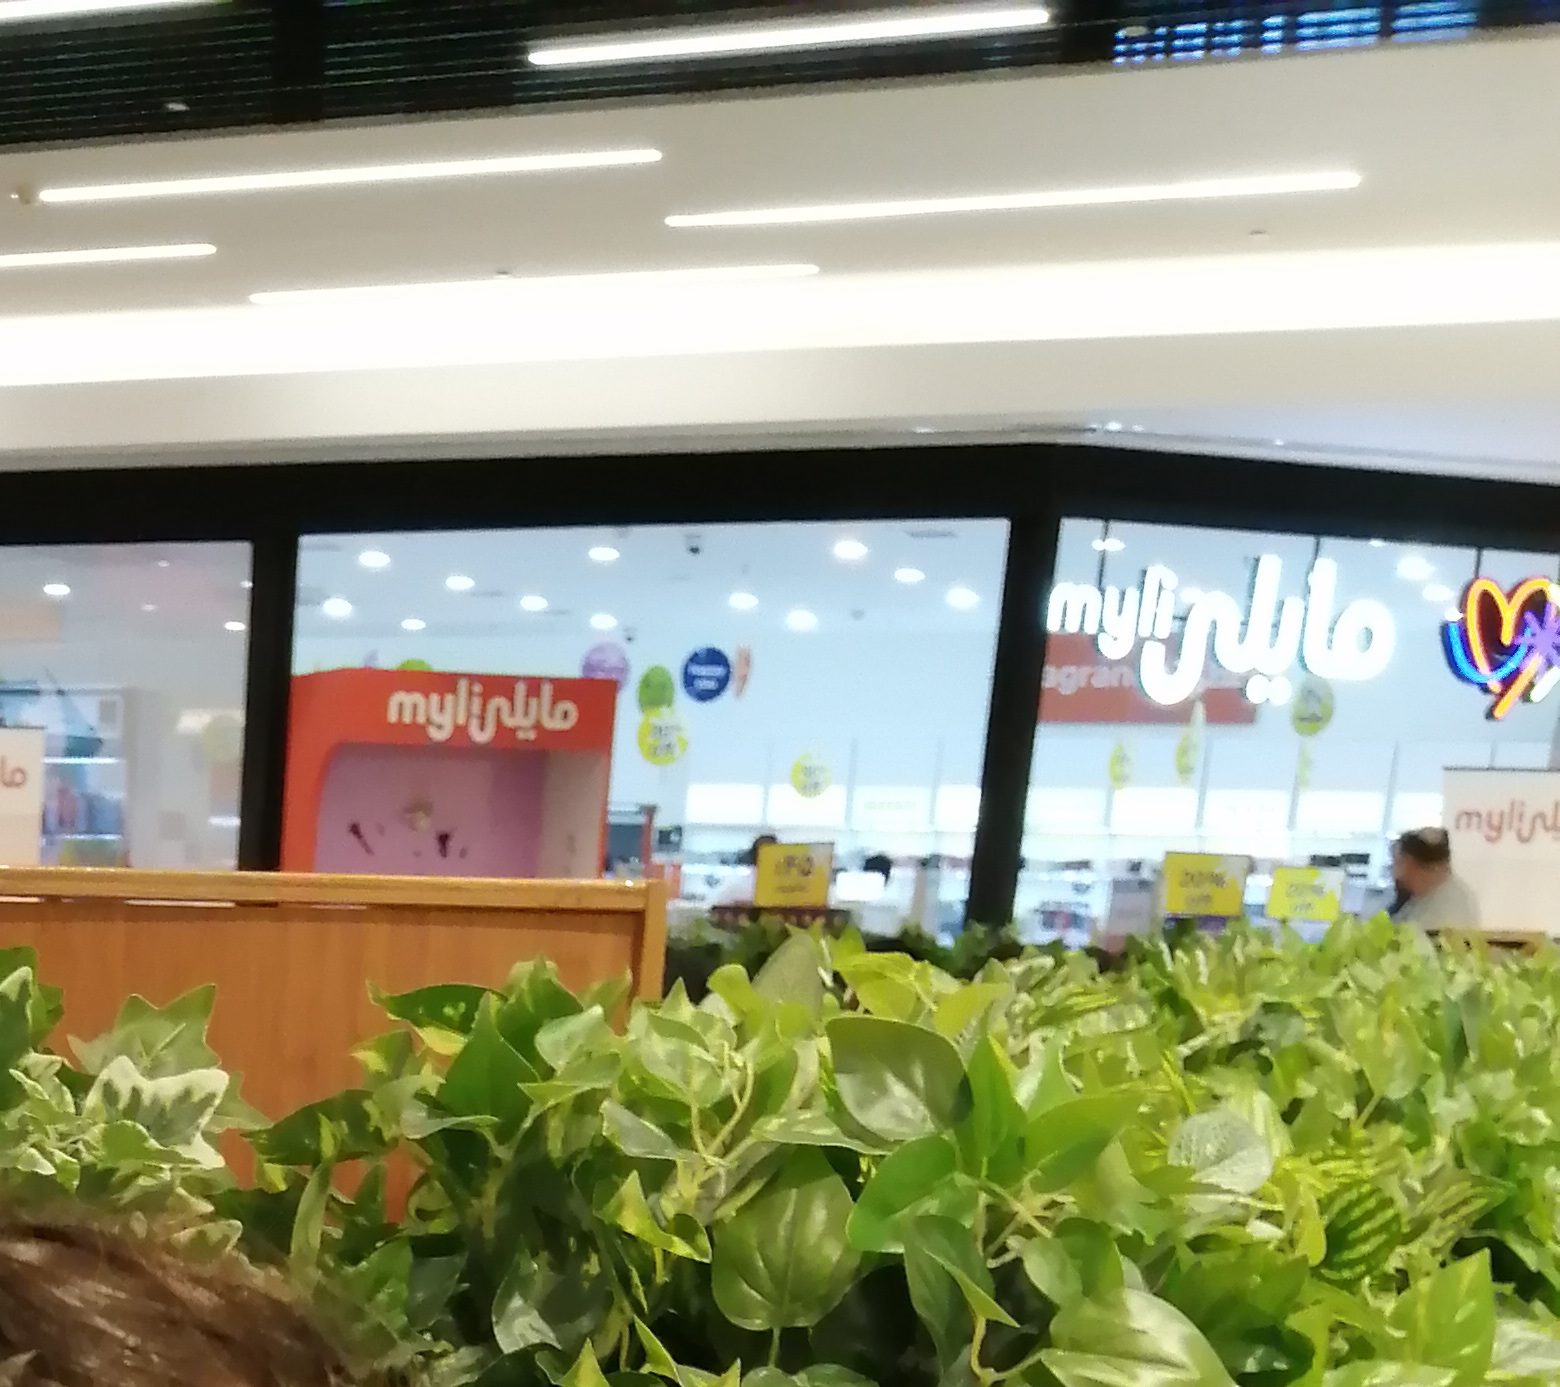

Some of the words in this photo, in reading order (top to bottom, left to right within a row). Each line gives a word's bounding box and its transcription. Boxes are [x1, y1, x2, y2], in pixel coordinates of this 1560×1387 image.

[1045, 563, 1179, 661] myli
[386, 677, 484, 744] myli
[1453, 797, 1525, 844] myli
